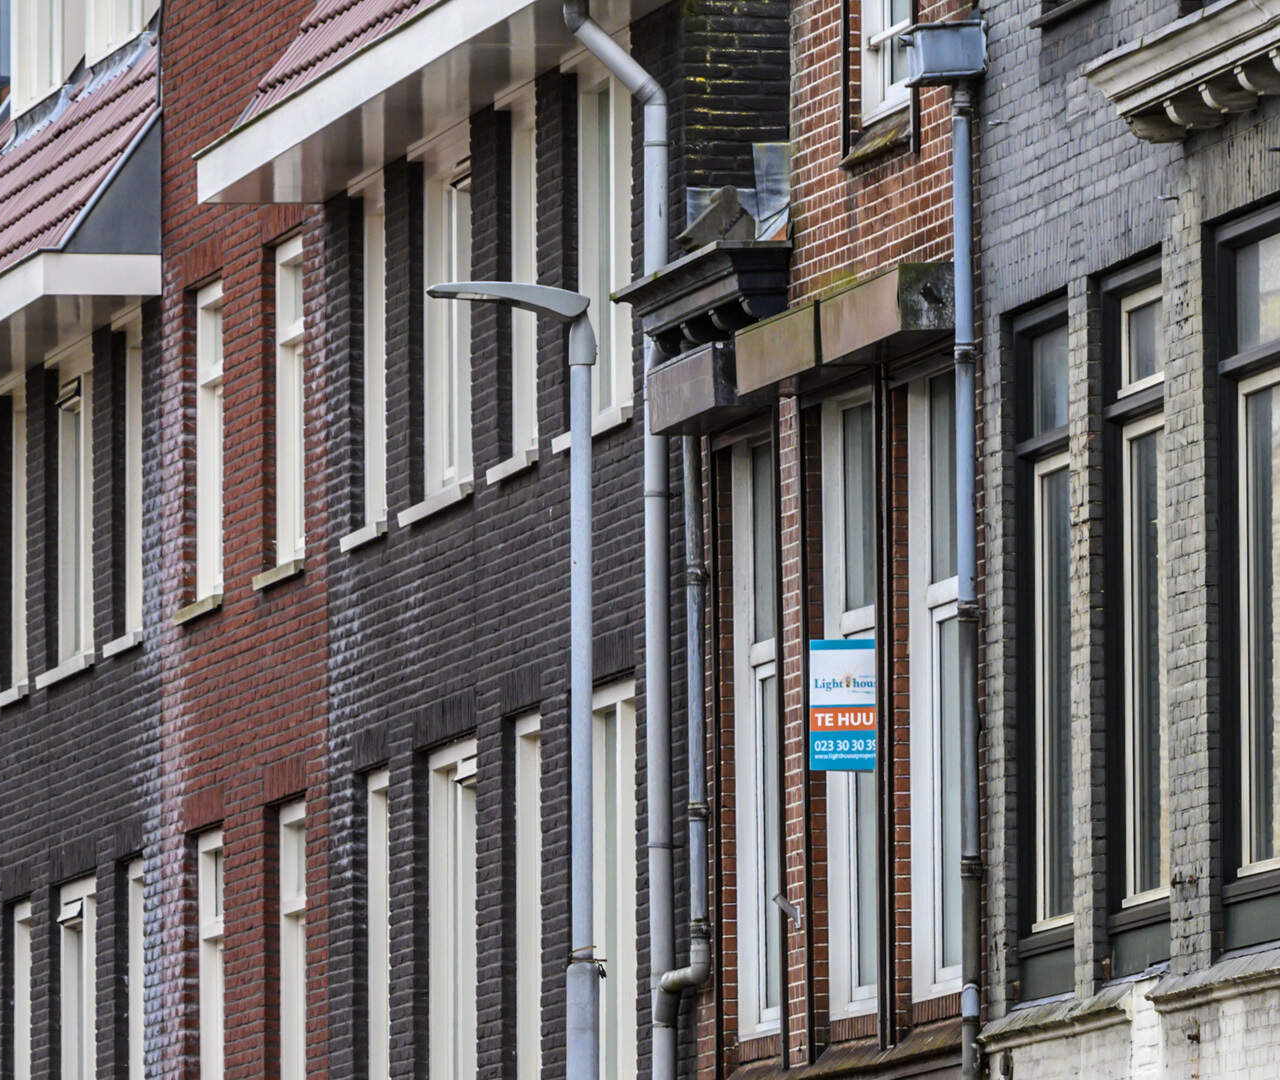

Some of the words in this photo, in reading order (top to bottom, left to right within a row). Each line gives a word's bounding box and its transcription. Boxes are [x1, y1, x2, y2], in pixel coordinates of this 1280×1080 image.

[815, 713, 834, 726] TE
[838, 711, 876, 725] HUU
[814, 740, 834, 751] 023
[836, 740, 849, 751] 30
[851, 740, 864, 751] 30
